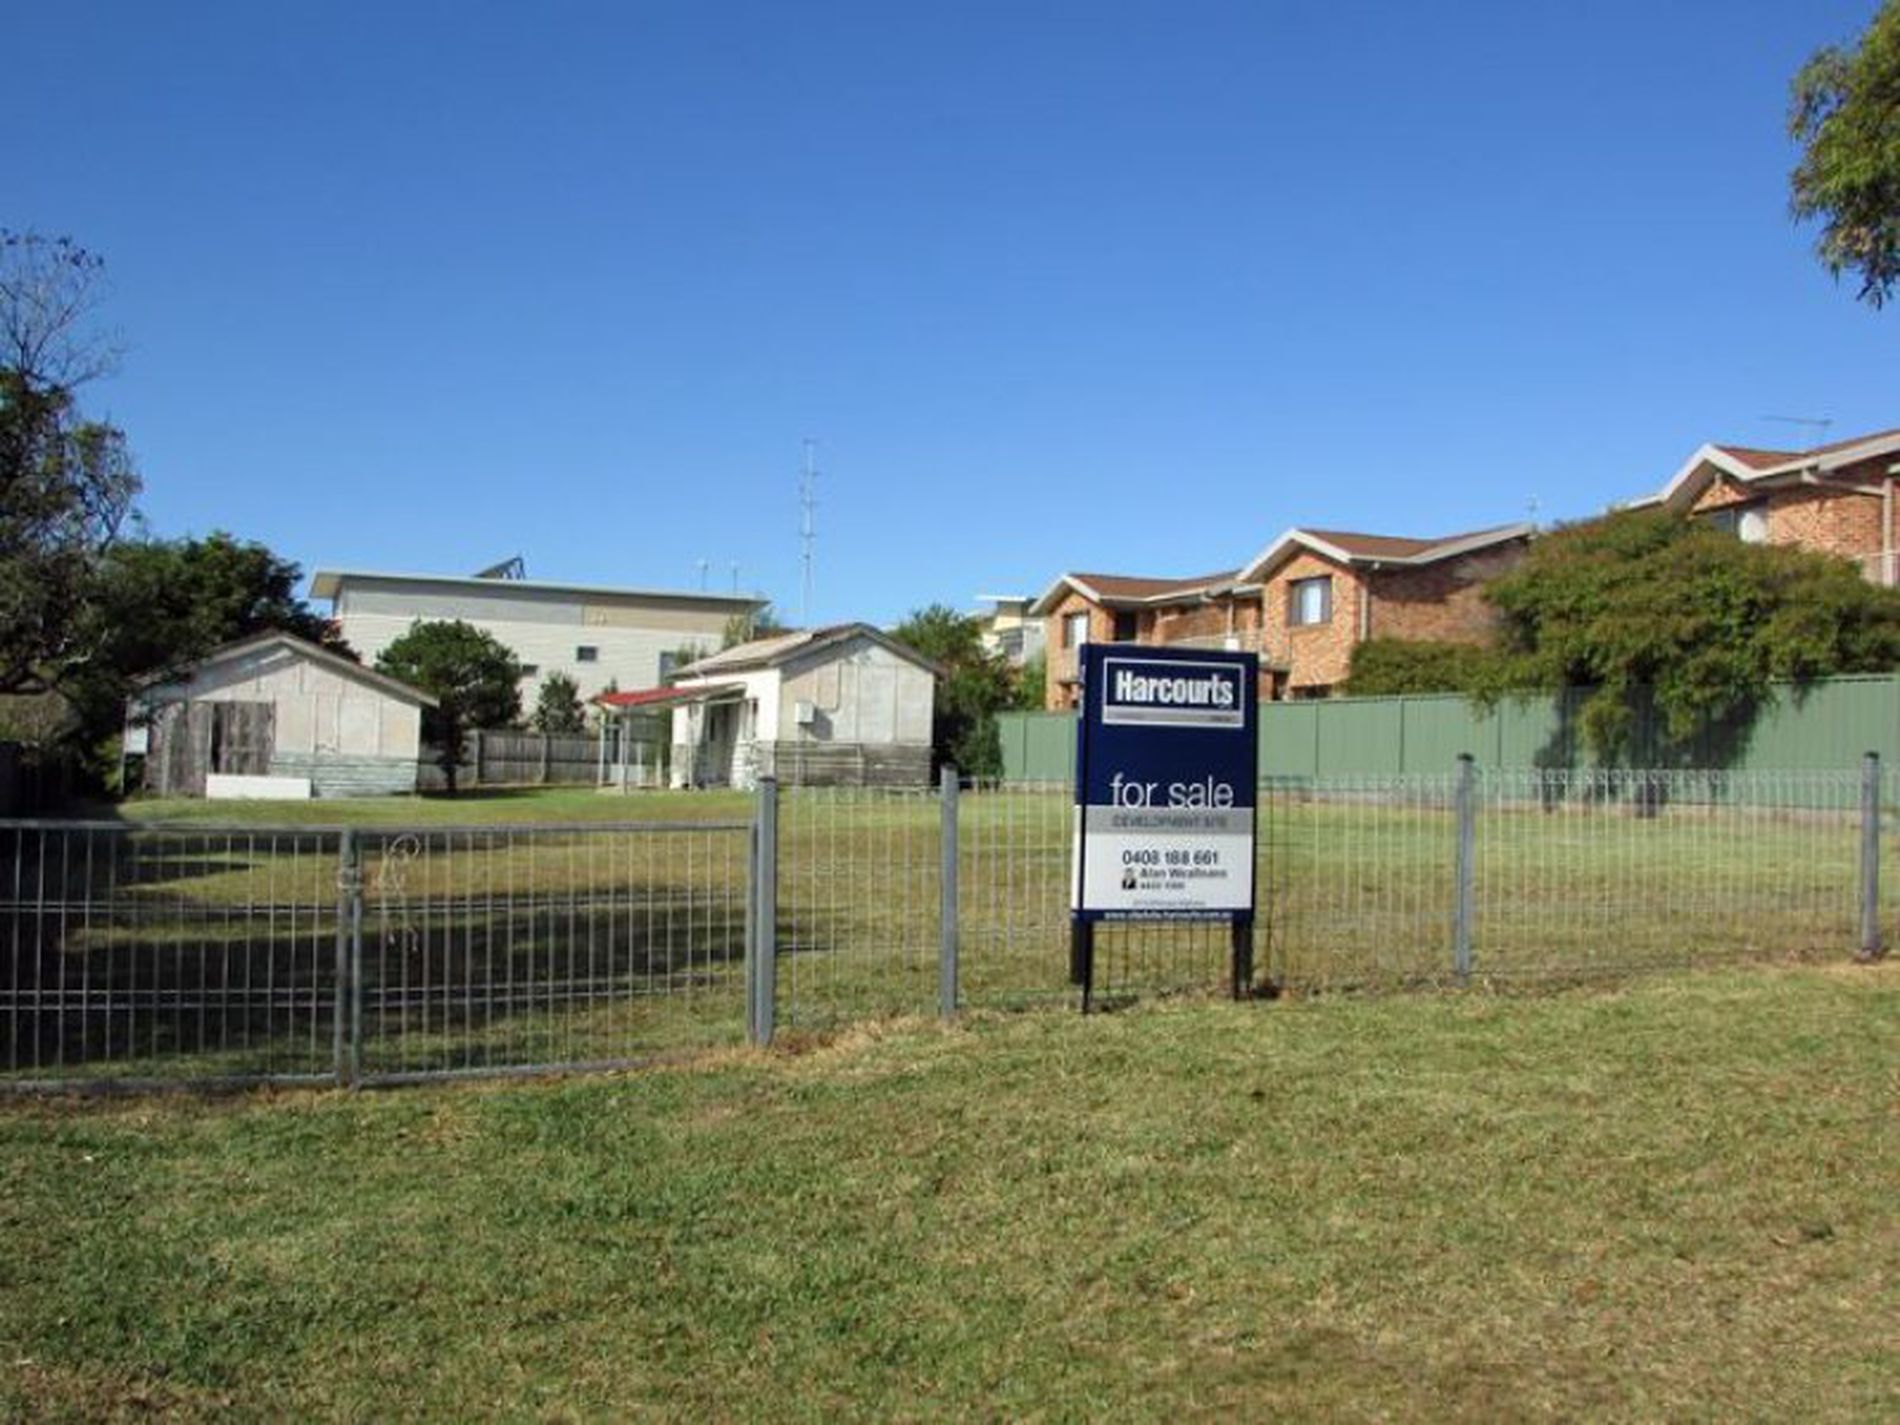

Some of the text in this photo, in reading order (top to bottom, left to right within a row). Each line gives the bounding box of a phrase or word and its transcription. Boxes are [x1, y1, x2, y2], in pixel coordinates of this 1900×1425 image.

[1115, 670, 1234, 705] Harcourts
[1109, 771, 1234, 809] for sale
